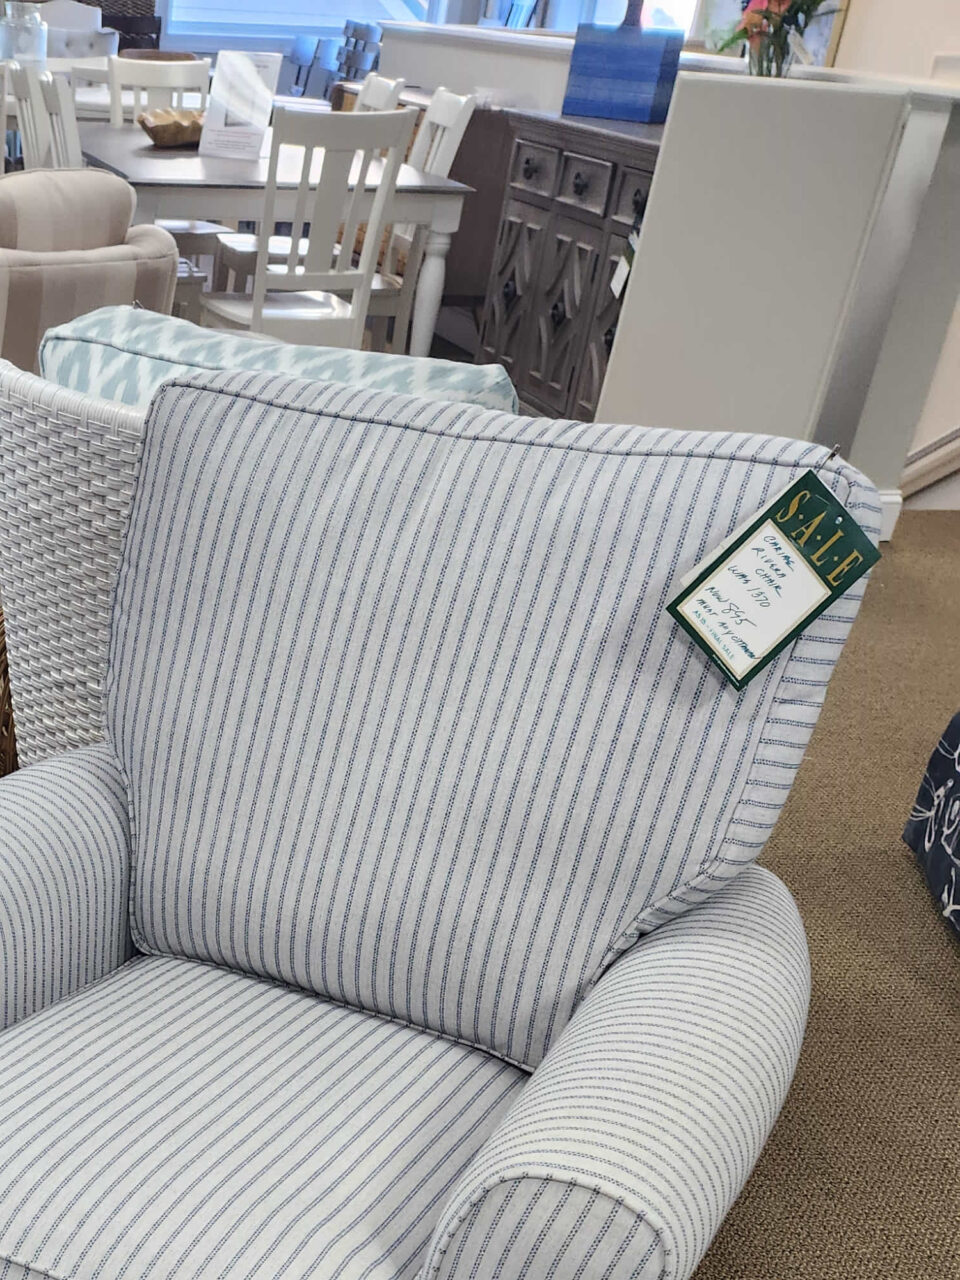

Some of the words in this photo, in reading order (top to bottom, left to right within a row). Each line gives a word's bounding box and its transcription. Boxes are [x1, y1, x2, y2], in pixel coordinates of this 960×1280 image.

[728, 566, 749, 584] WAS
[755, 569, 782, 597] CHAIR
[705, 586, 730, 603] NOW
